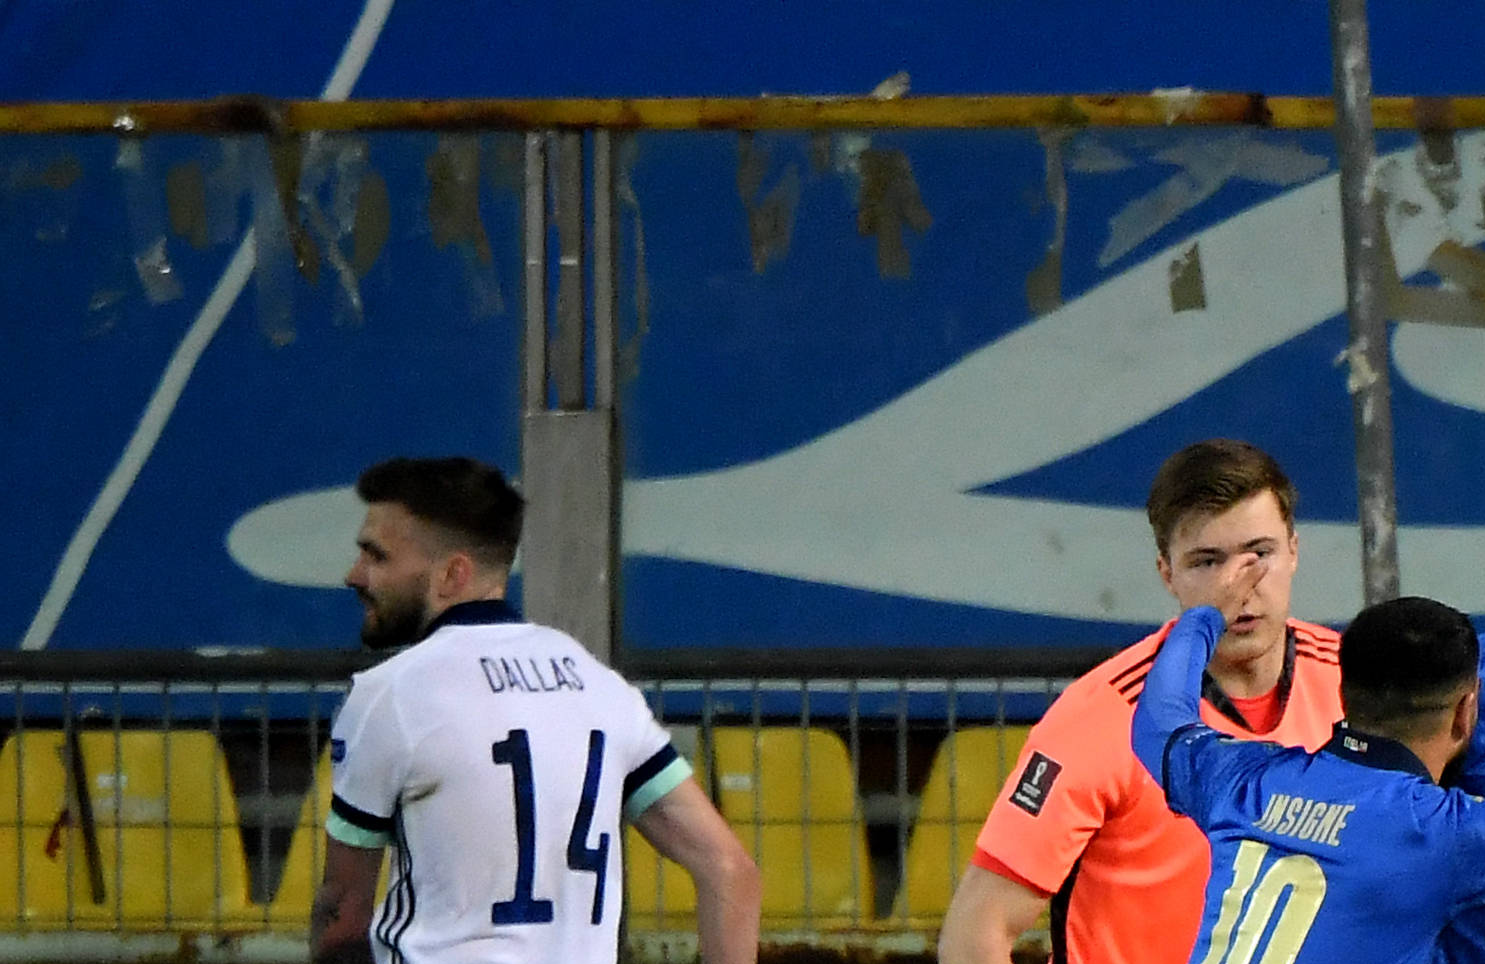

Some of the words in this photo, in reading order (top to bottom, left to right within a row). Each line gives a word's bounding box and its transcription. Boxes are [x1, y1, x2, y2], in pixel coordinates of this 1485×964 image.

[479, 656, 585, 694] DALLAS
[491, 728, 611, 926] 14
[1251, 794, 1356, 847] INSIGNE
